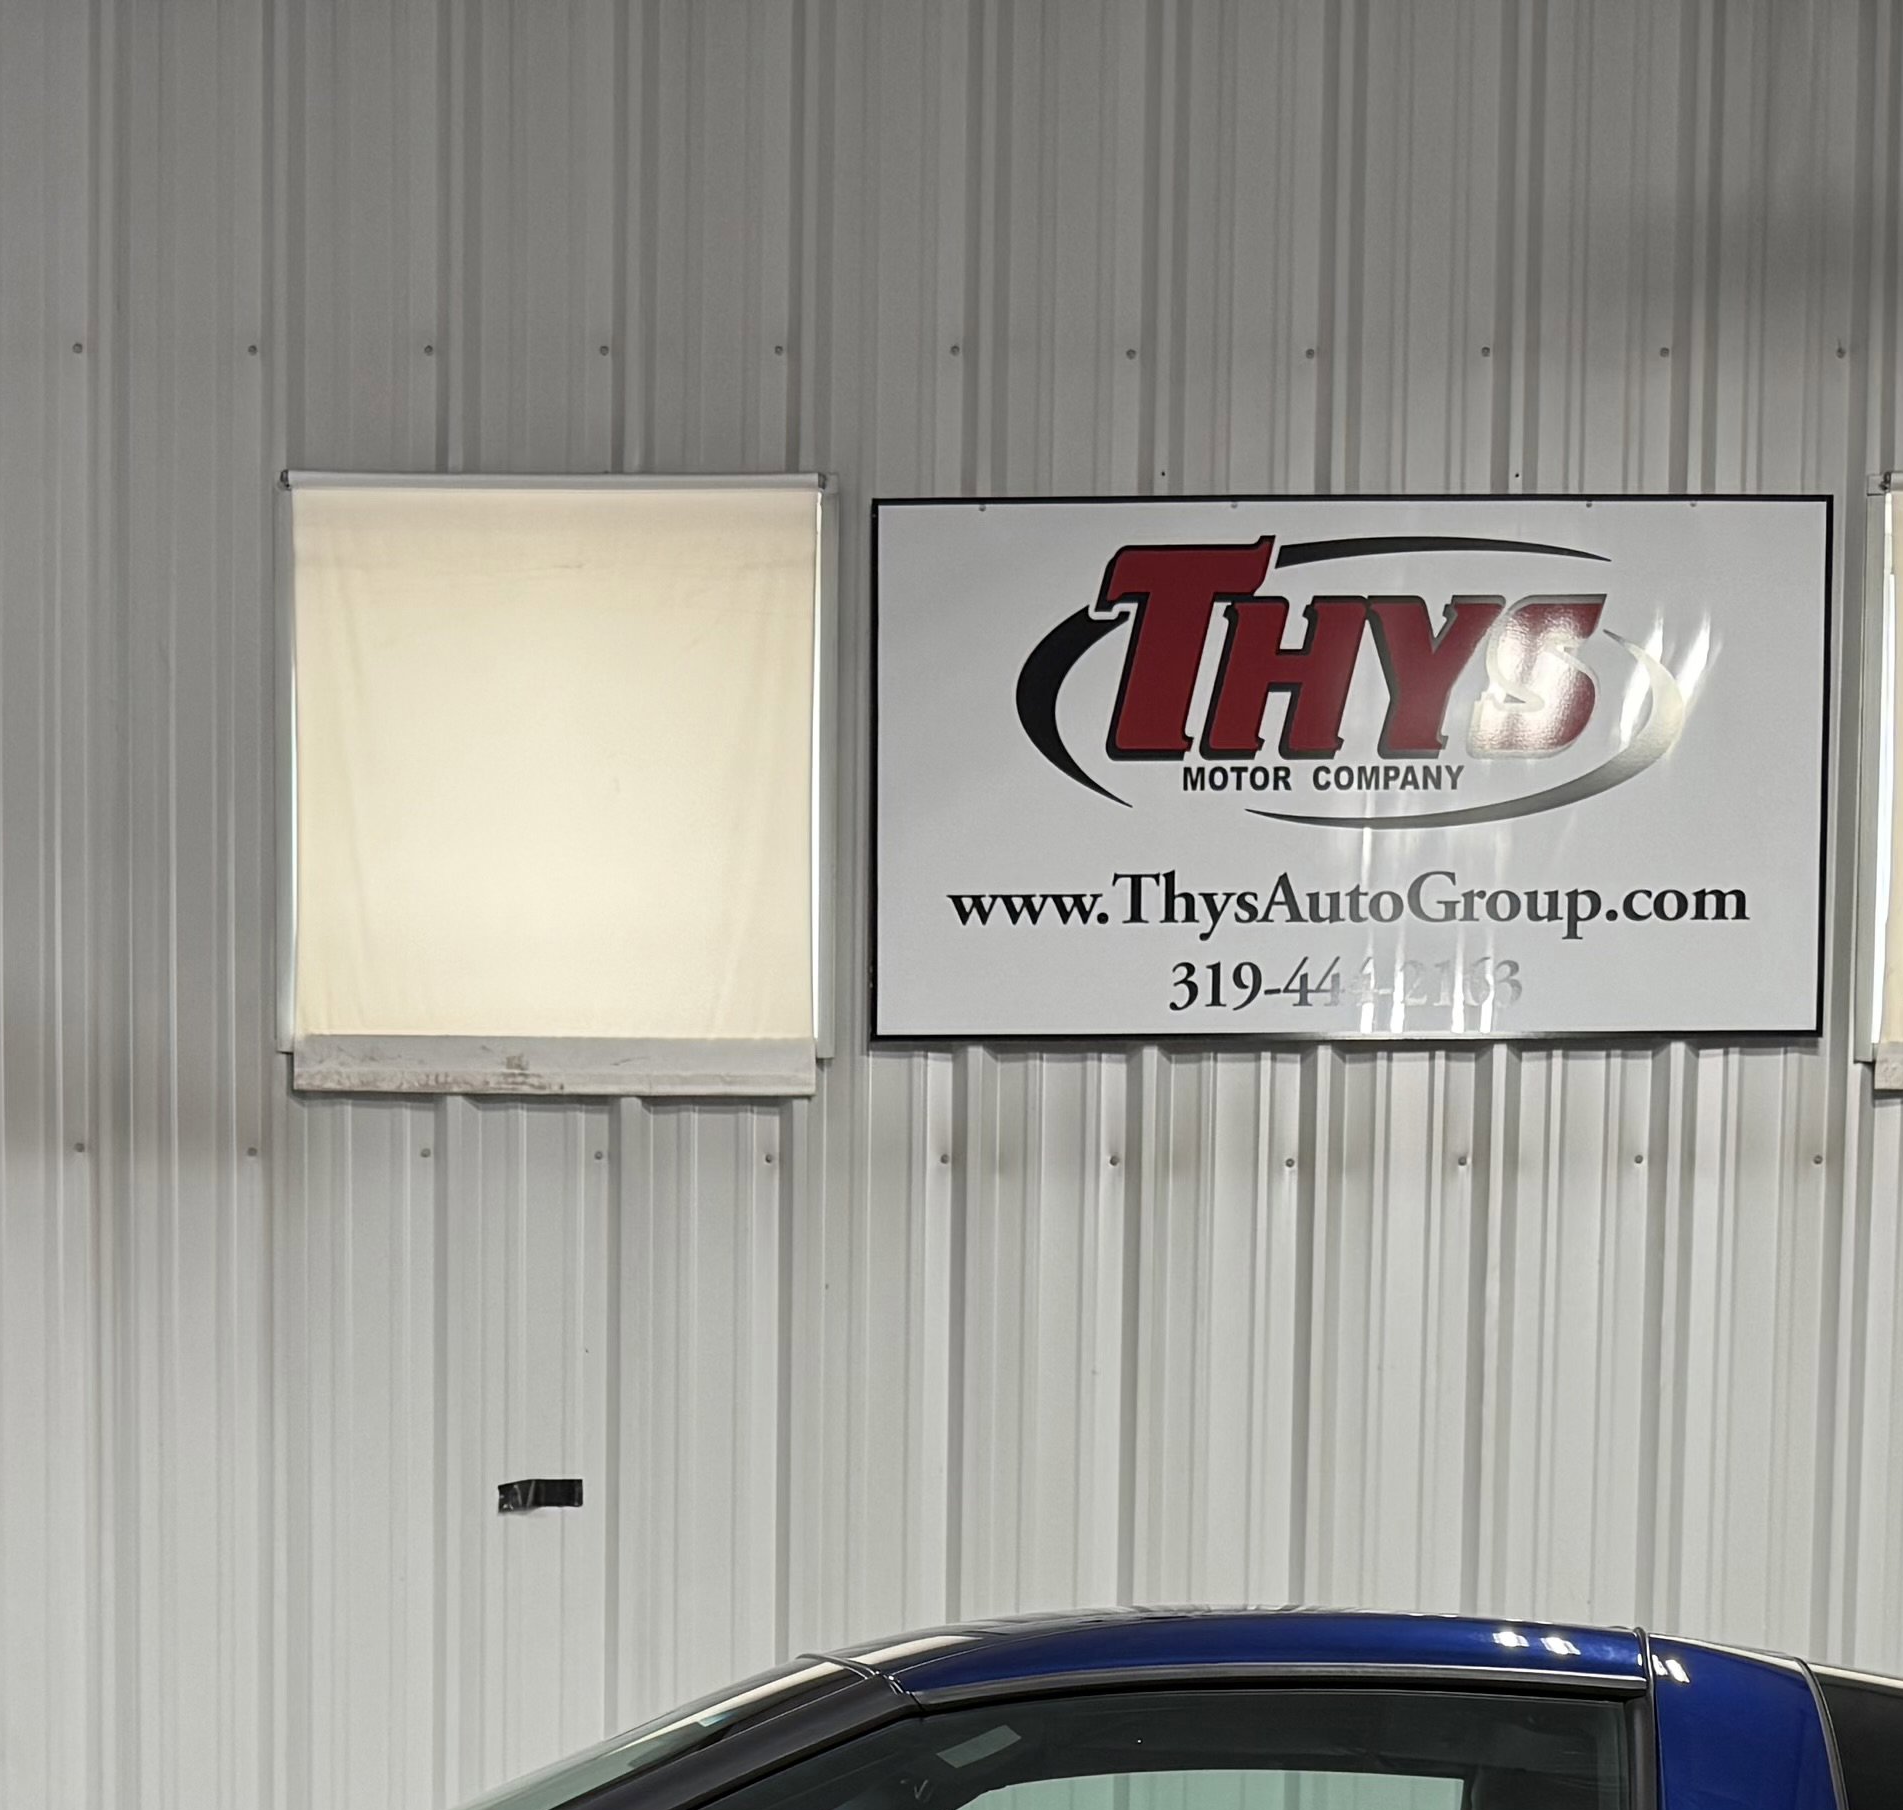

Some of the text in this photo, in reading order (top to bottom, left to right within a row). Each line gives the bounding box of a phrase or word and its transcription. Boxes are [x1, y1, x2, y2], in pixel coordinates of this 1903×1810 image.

[1095, 535, 1608, 760] THYS
[1182, 765, 1465, 791] MOTOR COMPANY
[946, 870, 1751, 941] www.ThysAutoGroup.com
